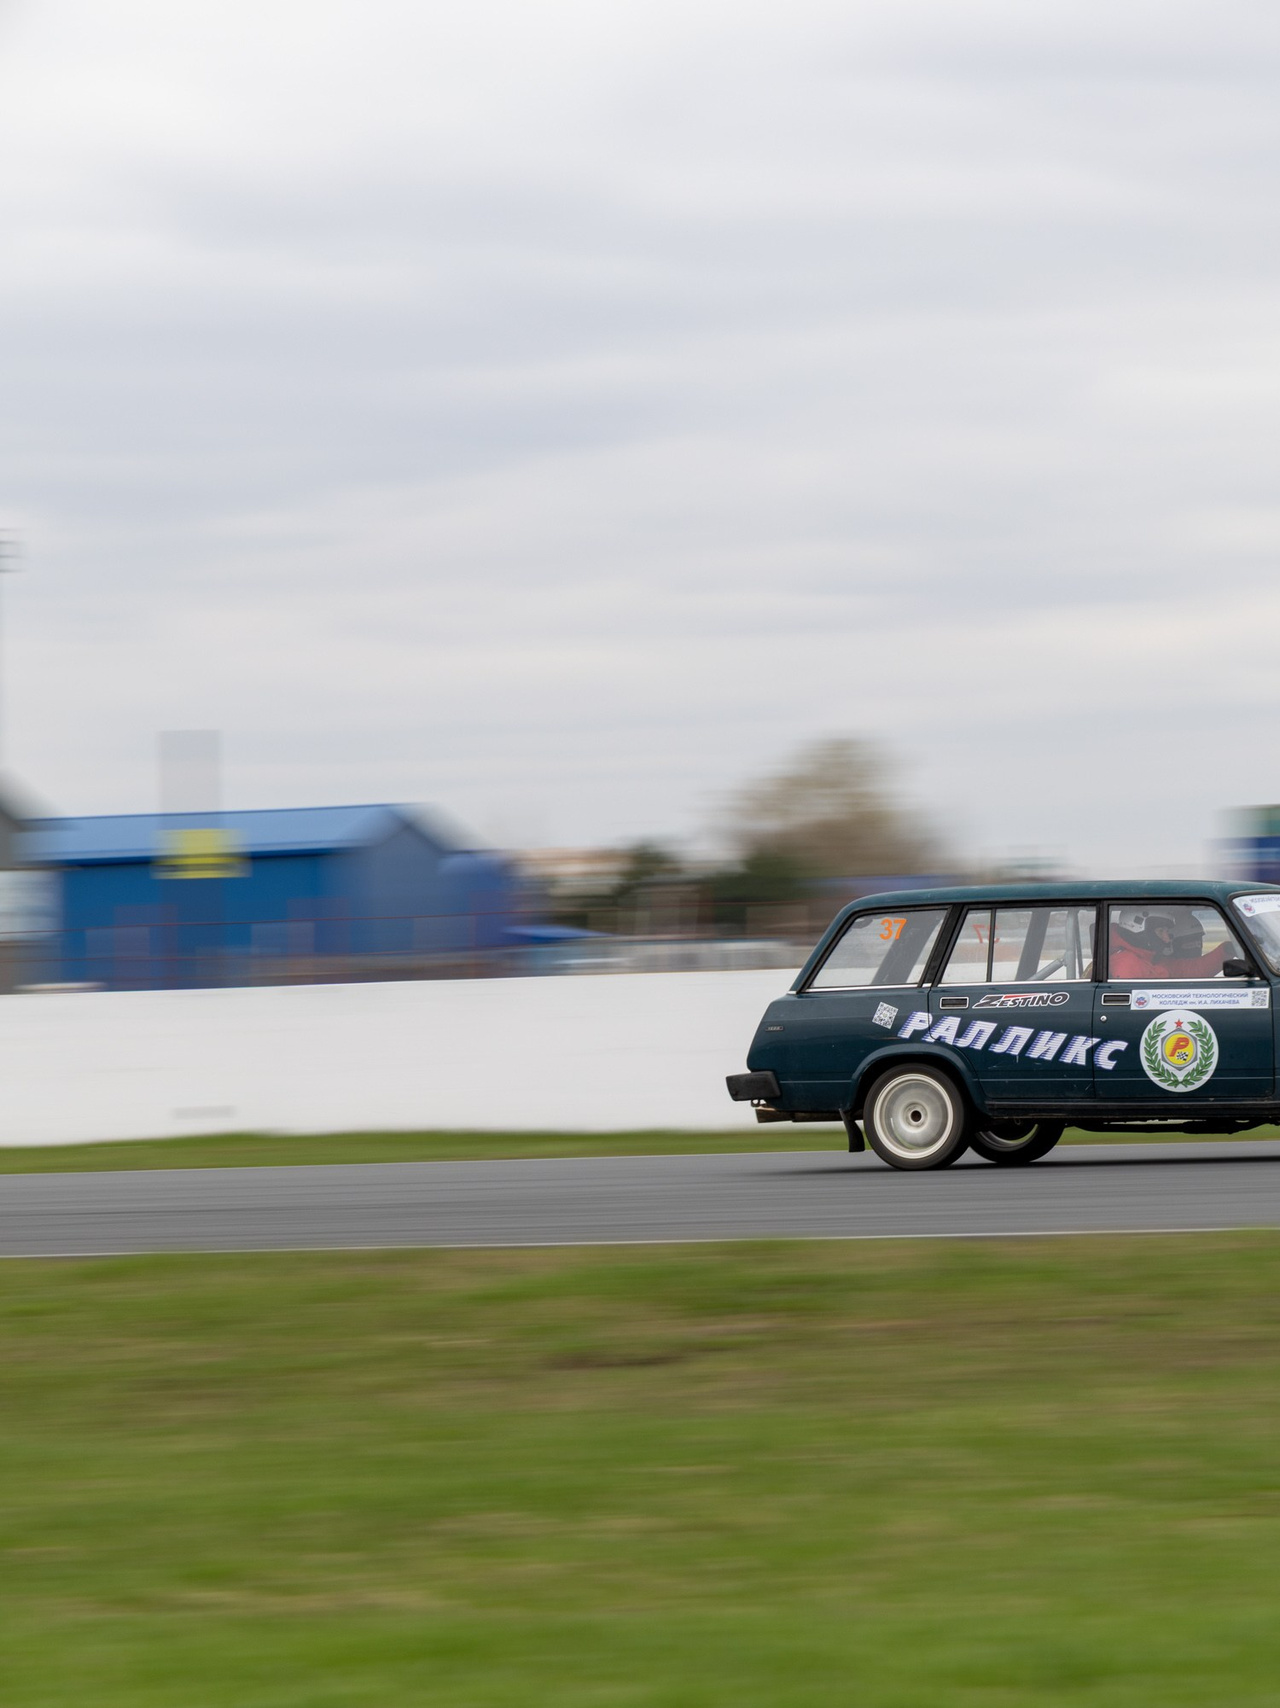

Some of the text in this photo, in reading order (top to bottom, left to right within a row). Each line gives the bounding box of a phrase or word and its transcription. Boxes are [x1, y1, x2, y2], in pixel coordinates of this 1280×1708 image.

[879, 918, 907, 940] 37
[972, 992, 1070, 1009] ZESTINO
[897, 1011, 1129, 1071] РАЛЛИКС
